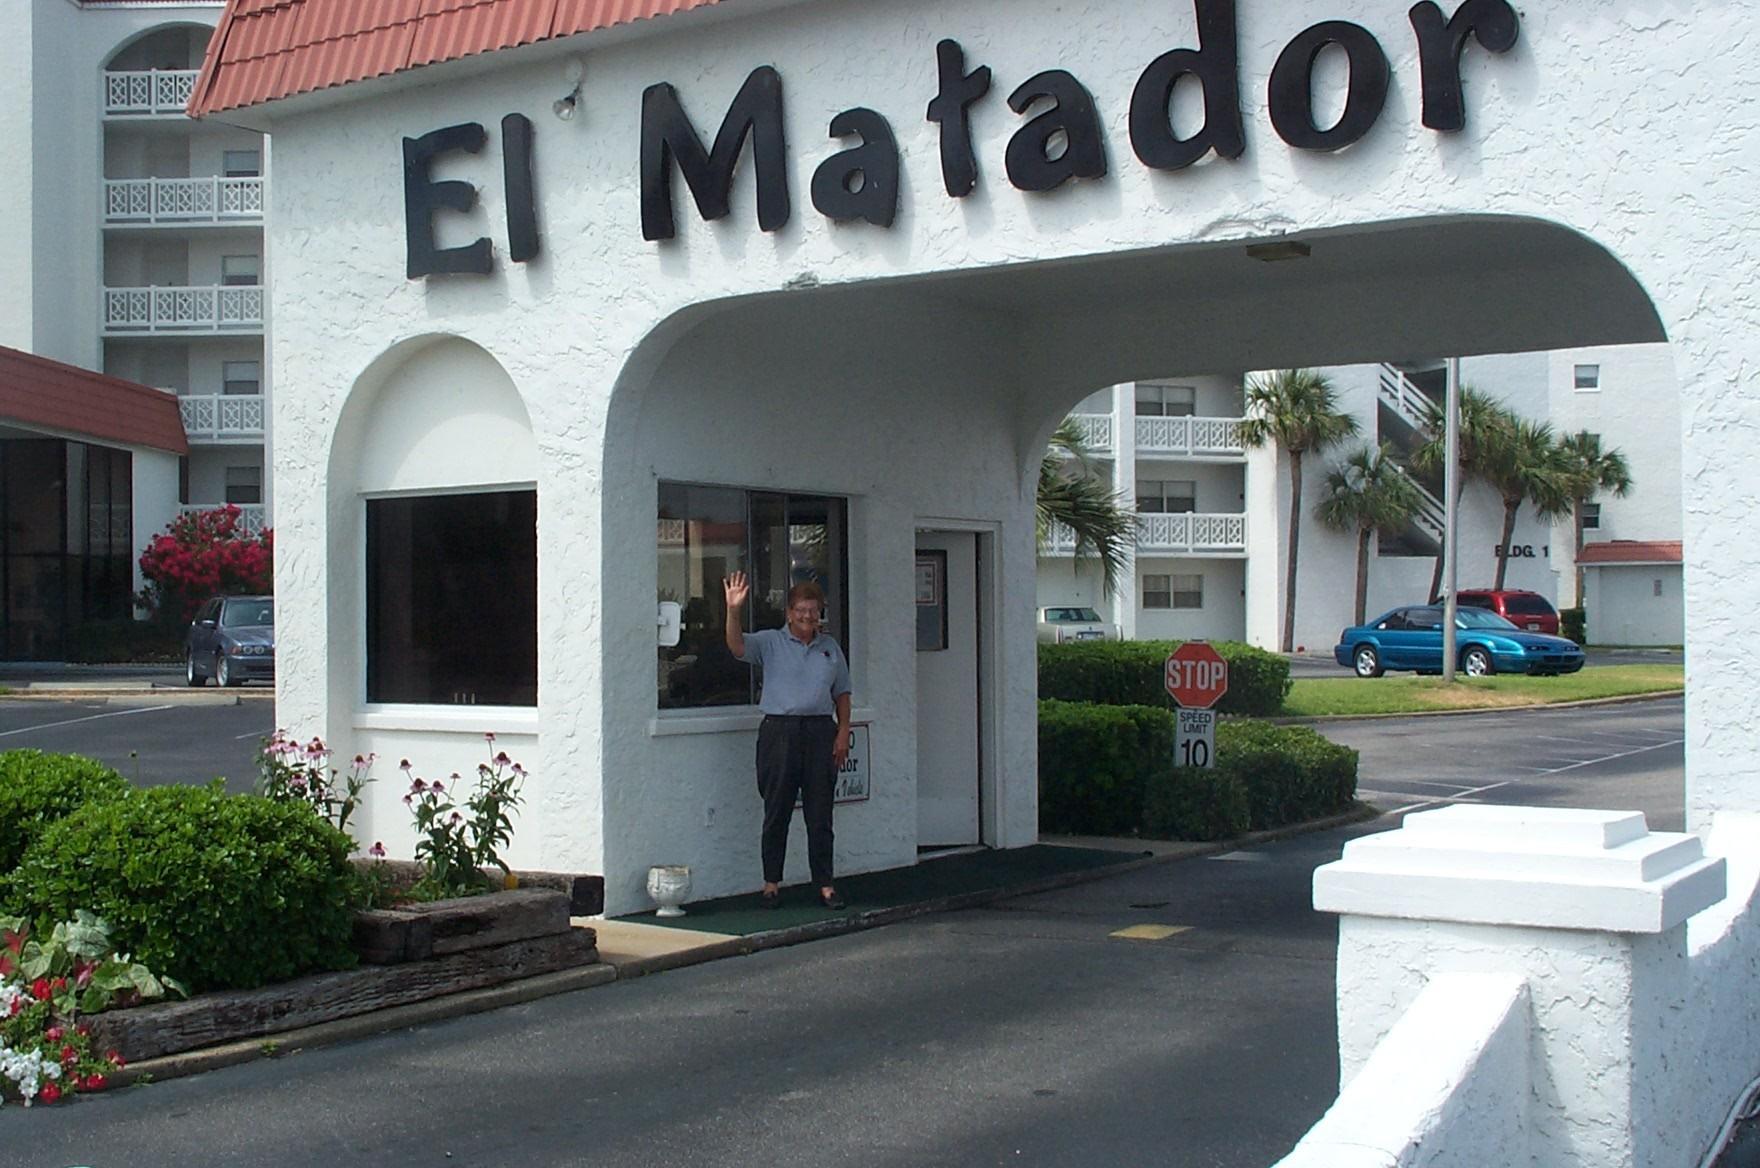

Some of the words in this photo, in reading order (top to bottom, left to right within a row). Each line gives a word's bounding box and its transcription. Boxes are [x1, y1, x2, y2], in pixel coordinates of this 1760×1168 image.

[402, 112, 540, 280] El
[640, 0, 1519, 242] Matador
[1542, 545, 1549, 557] 1
[1167, 659, 1225, 690] STOP
[1179, 711, 1212, 724] SPEED
[1183, 724, 1208, 734] LIMIT
[1181, 739, 1208, 768] 10
